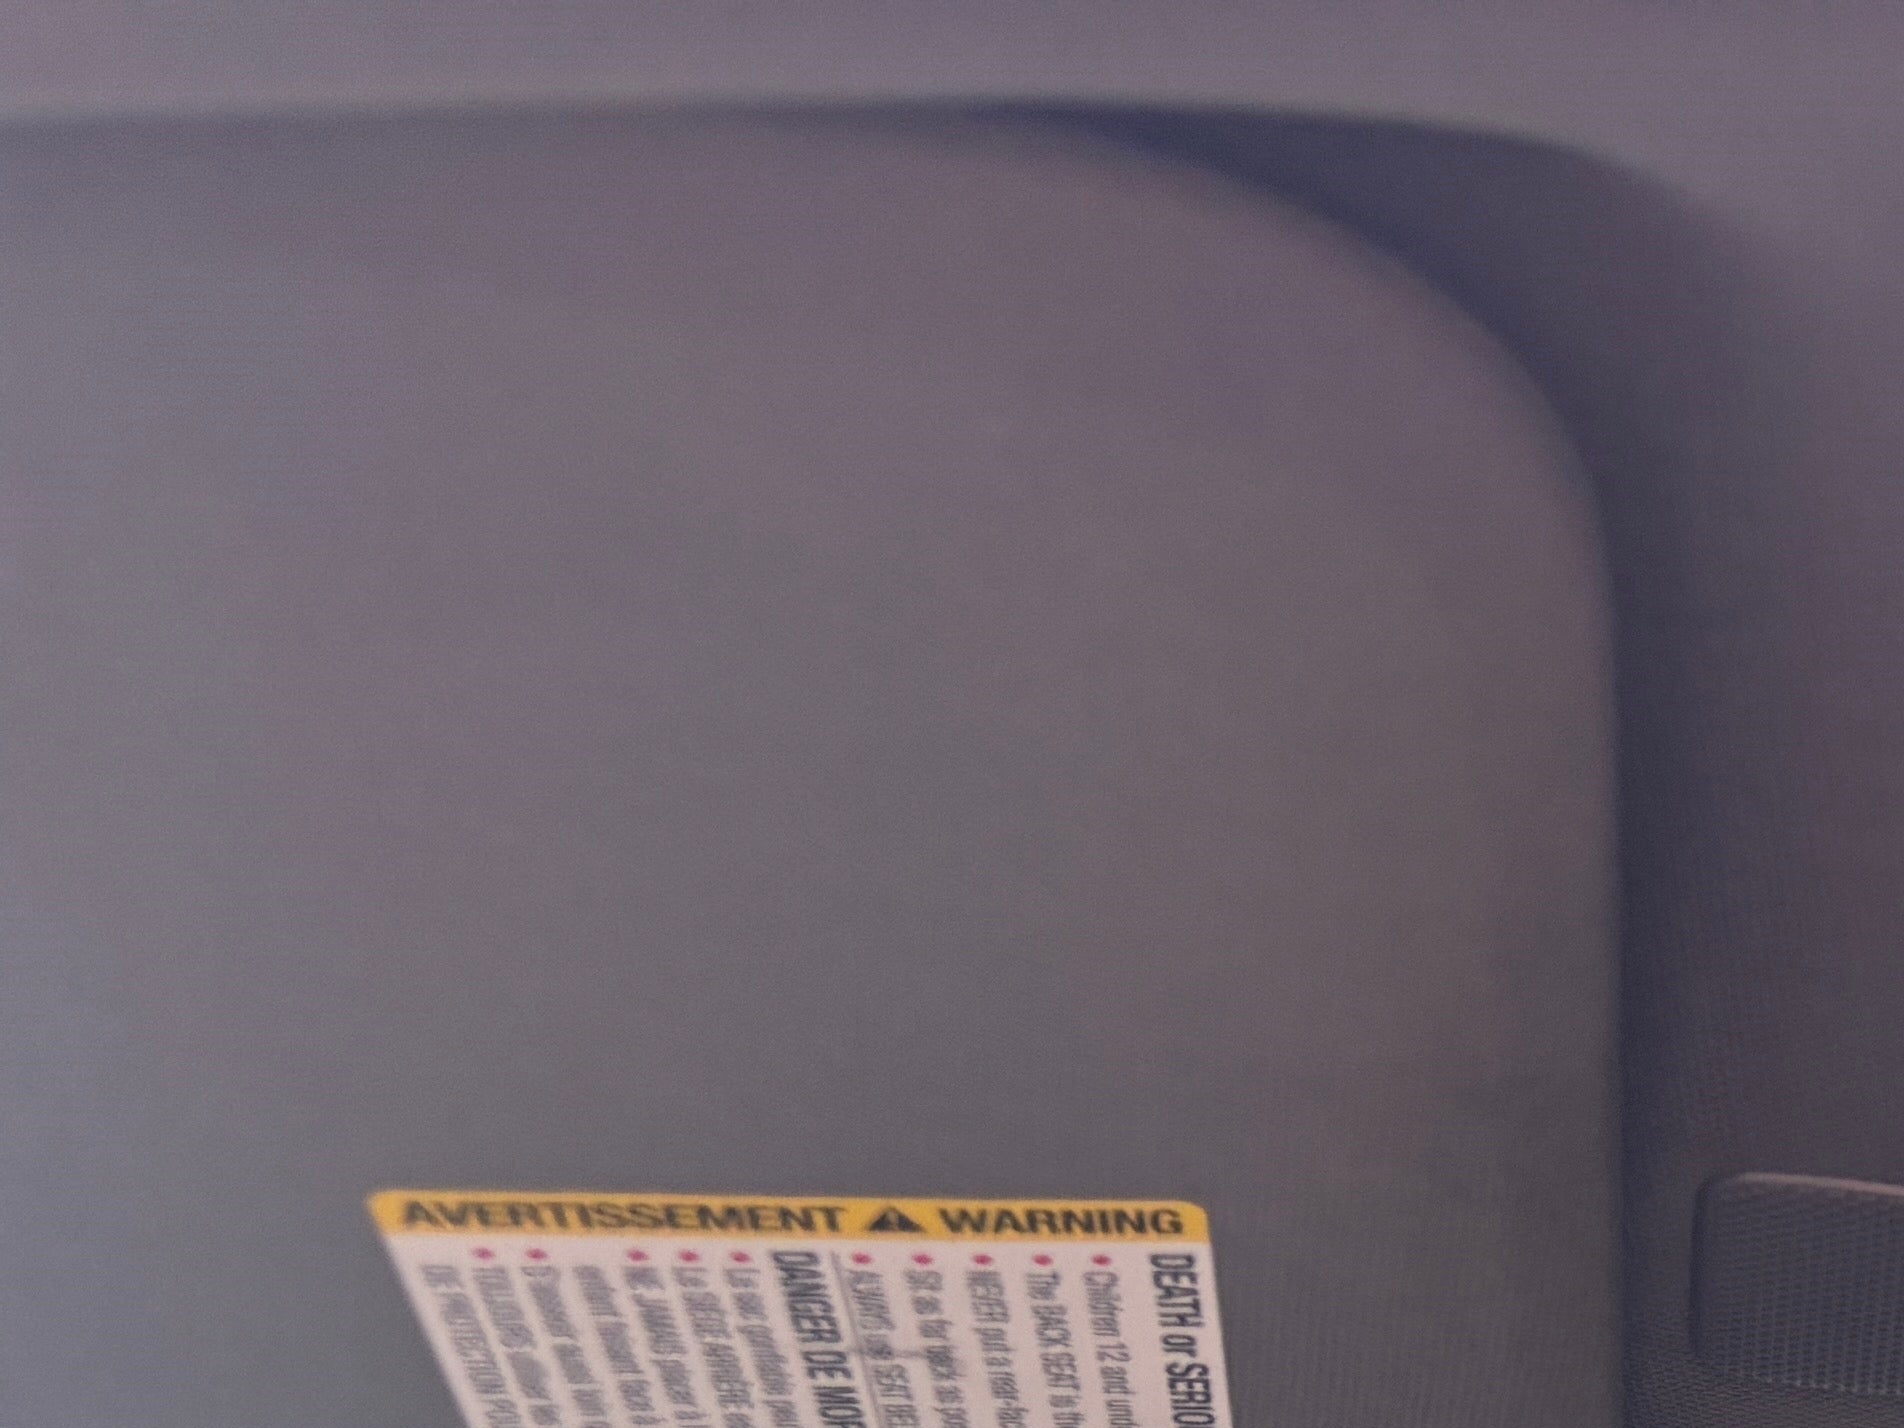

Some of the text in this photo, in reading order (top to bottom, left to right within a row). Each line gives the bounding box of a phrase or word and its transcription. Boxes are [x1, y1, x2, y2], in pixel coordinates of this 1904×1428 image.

[404, 1200, 1184, 1235] AVERTISSEMENT WARNING
[768, 1249, 843, 1344] DANGER
[1024, 1270, 1062, 1301] The
[1081, 1269, 1124, 1337] Children
[1147, 1252, 1204, 1328] DEATH
[1029, 1303, 1072, 1349] BACK
[1094, 1340, 1133, 1363] 12
[1159, 1332, 1198, 1358] or
[798, 1348, 853, 1380] DE
[1037, 1350, 1082, 1392] SEAT
[1098, 1364, 1136, 1396] and
